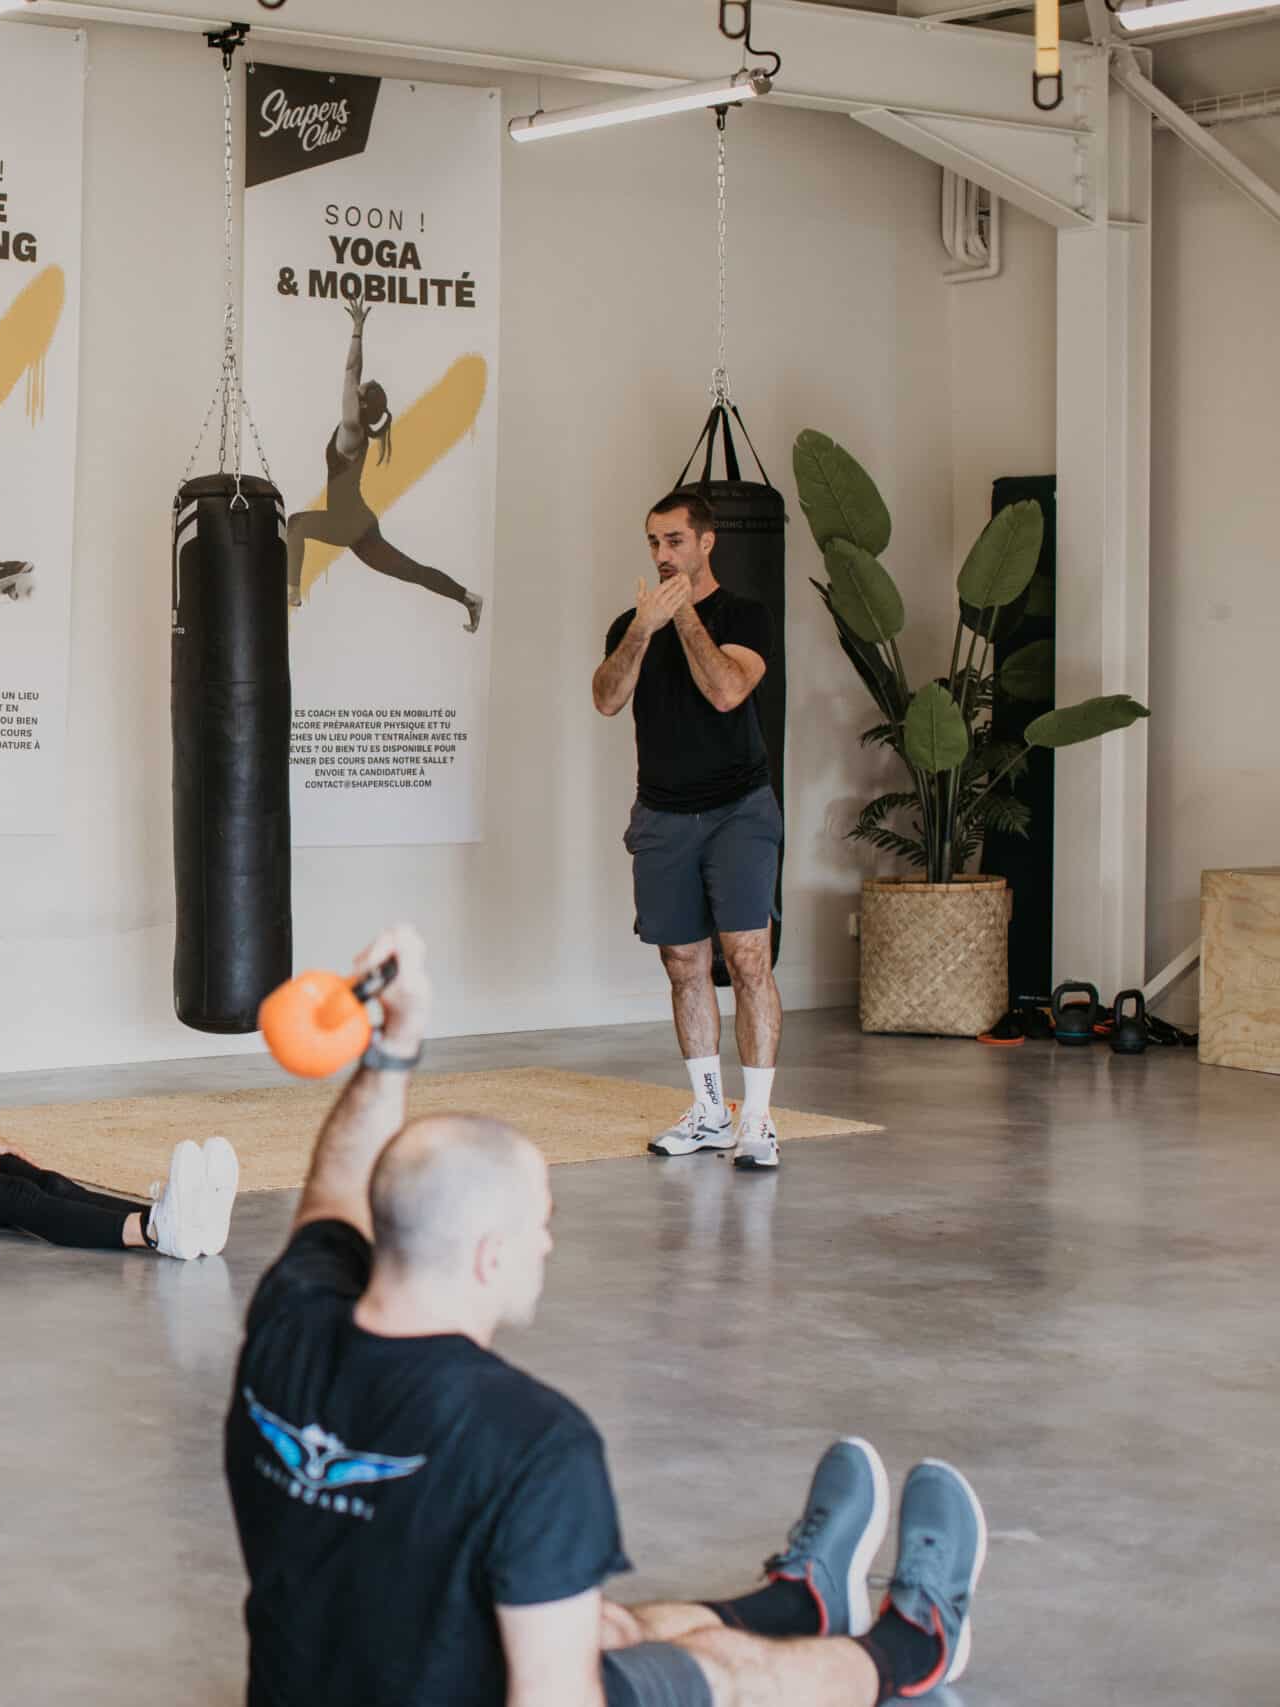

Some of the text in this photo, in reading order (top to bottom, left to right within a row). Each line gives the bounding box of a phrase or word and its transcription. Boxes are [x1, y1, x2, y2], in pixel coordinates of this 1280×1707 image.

[259, 88, 350, 139] Shapers
[302, 123, 342, 151] Club
[325, 204, 404, 231] SOON
[328, 235, 422, 270] YOGA
[277, 266, 476, 308] & MOBILITÉ
[1, 692, 15, 700] UN
[18, 692, 39, 700] LIEU
[0, 729, 32, 737] COURS
[16, 717, 38, 725] BIEN
